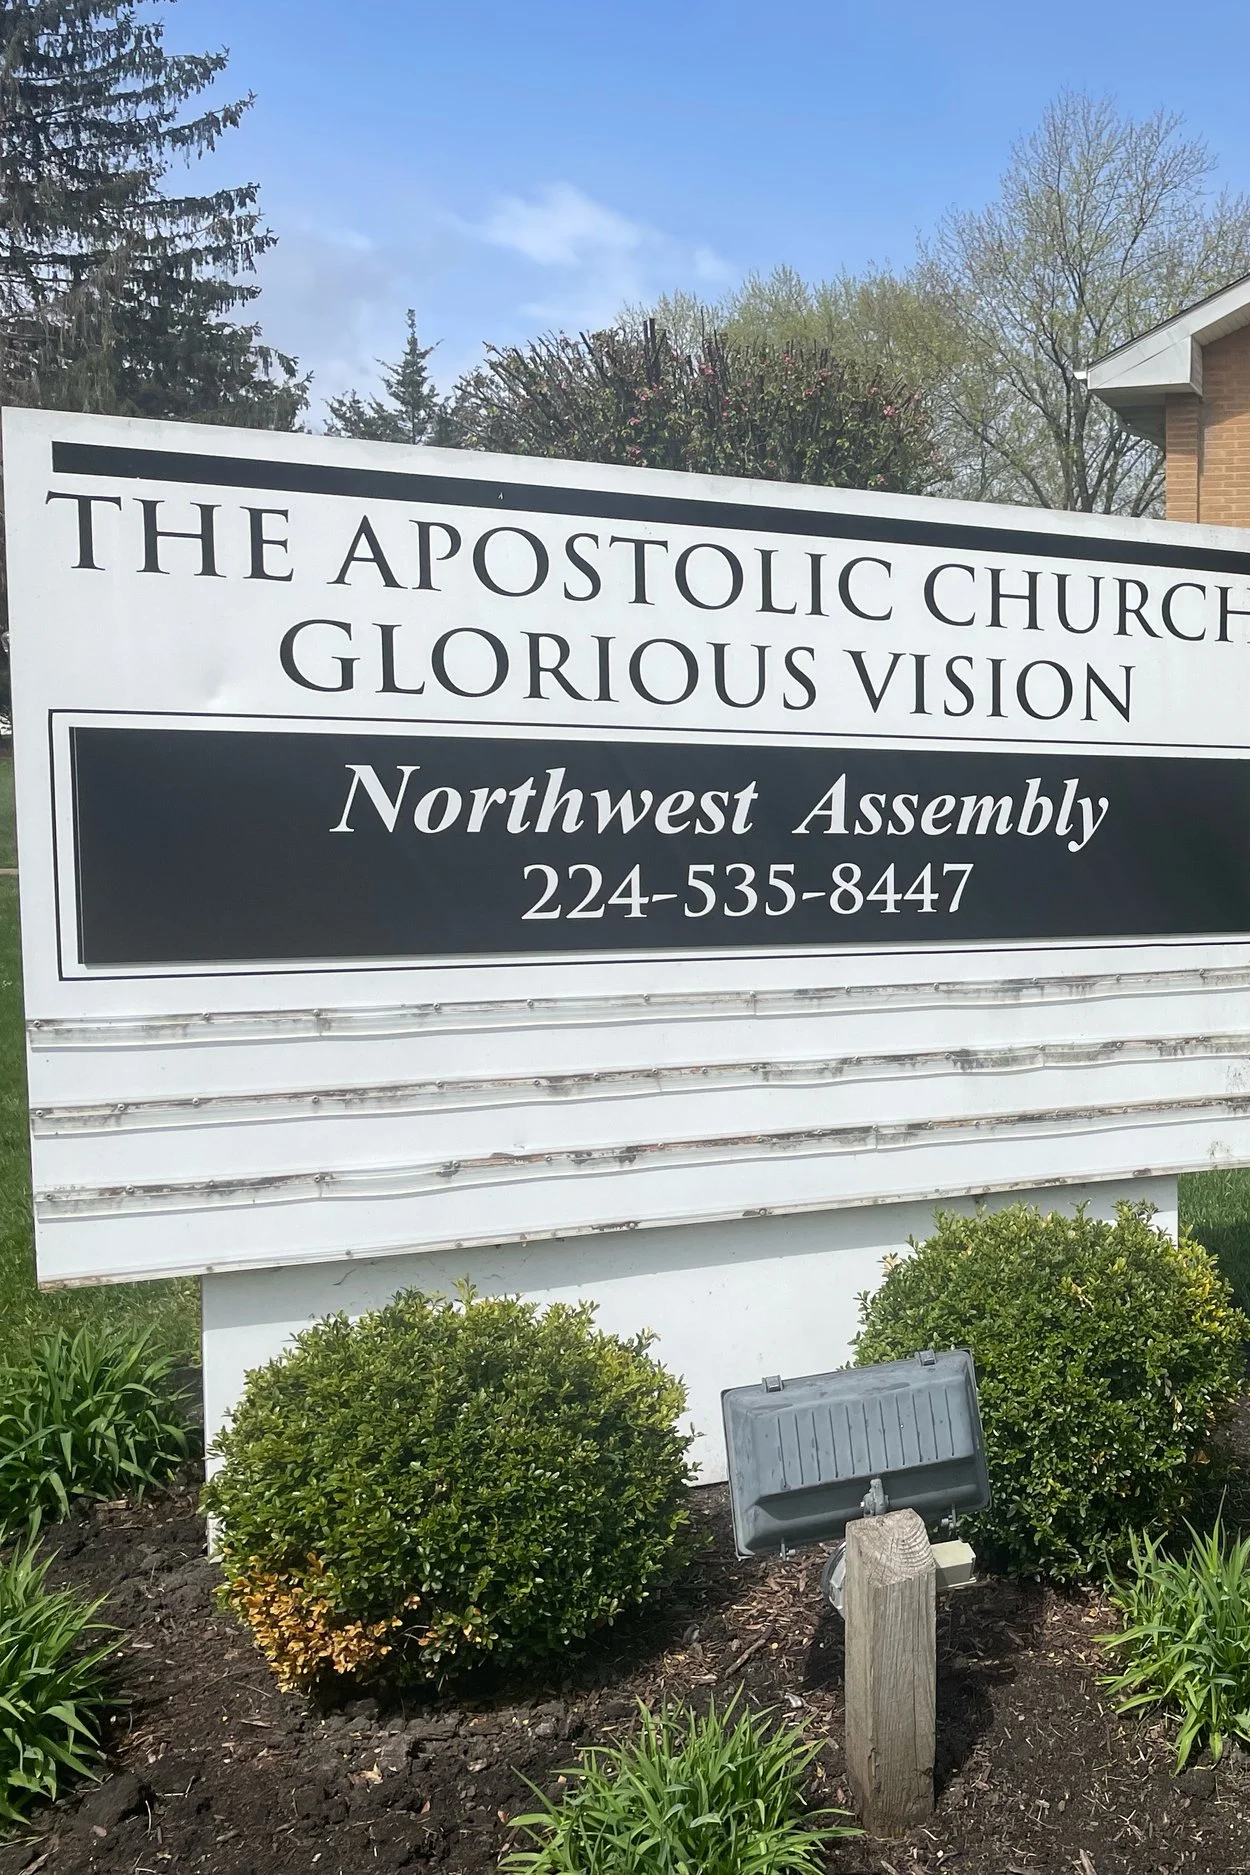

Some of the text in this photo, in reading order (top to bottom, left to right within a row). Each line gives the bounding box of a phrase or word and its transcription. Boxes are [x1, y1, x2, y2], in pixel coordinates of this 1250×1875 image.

[45, 490, 294, 583] THE
[327, 514, 893, 621] APOSTOLIC
[279, 619, 1137, 723] GLORIOUS VISION
[329, 764, 1110, 853] Northwest Assembly
[521, 862, 975, 920] 224-535-8447
